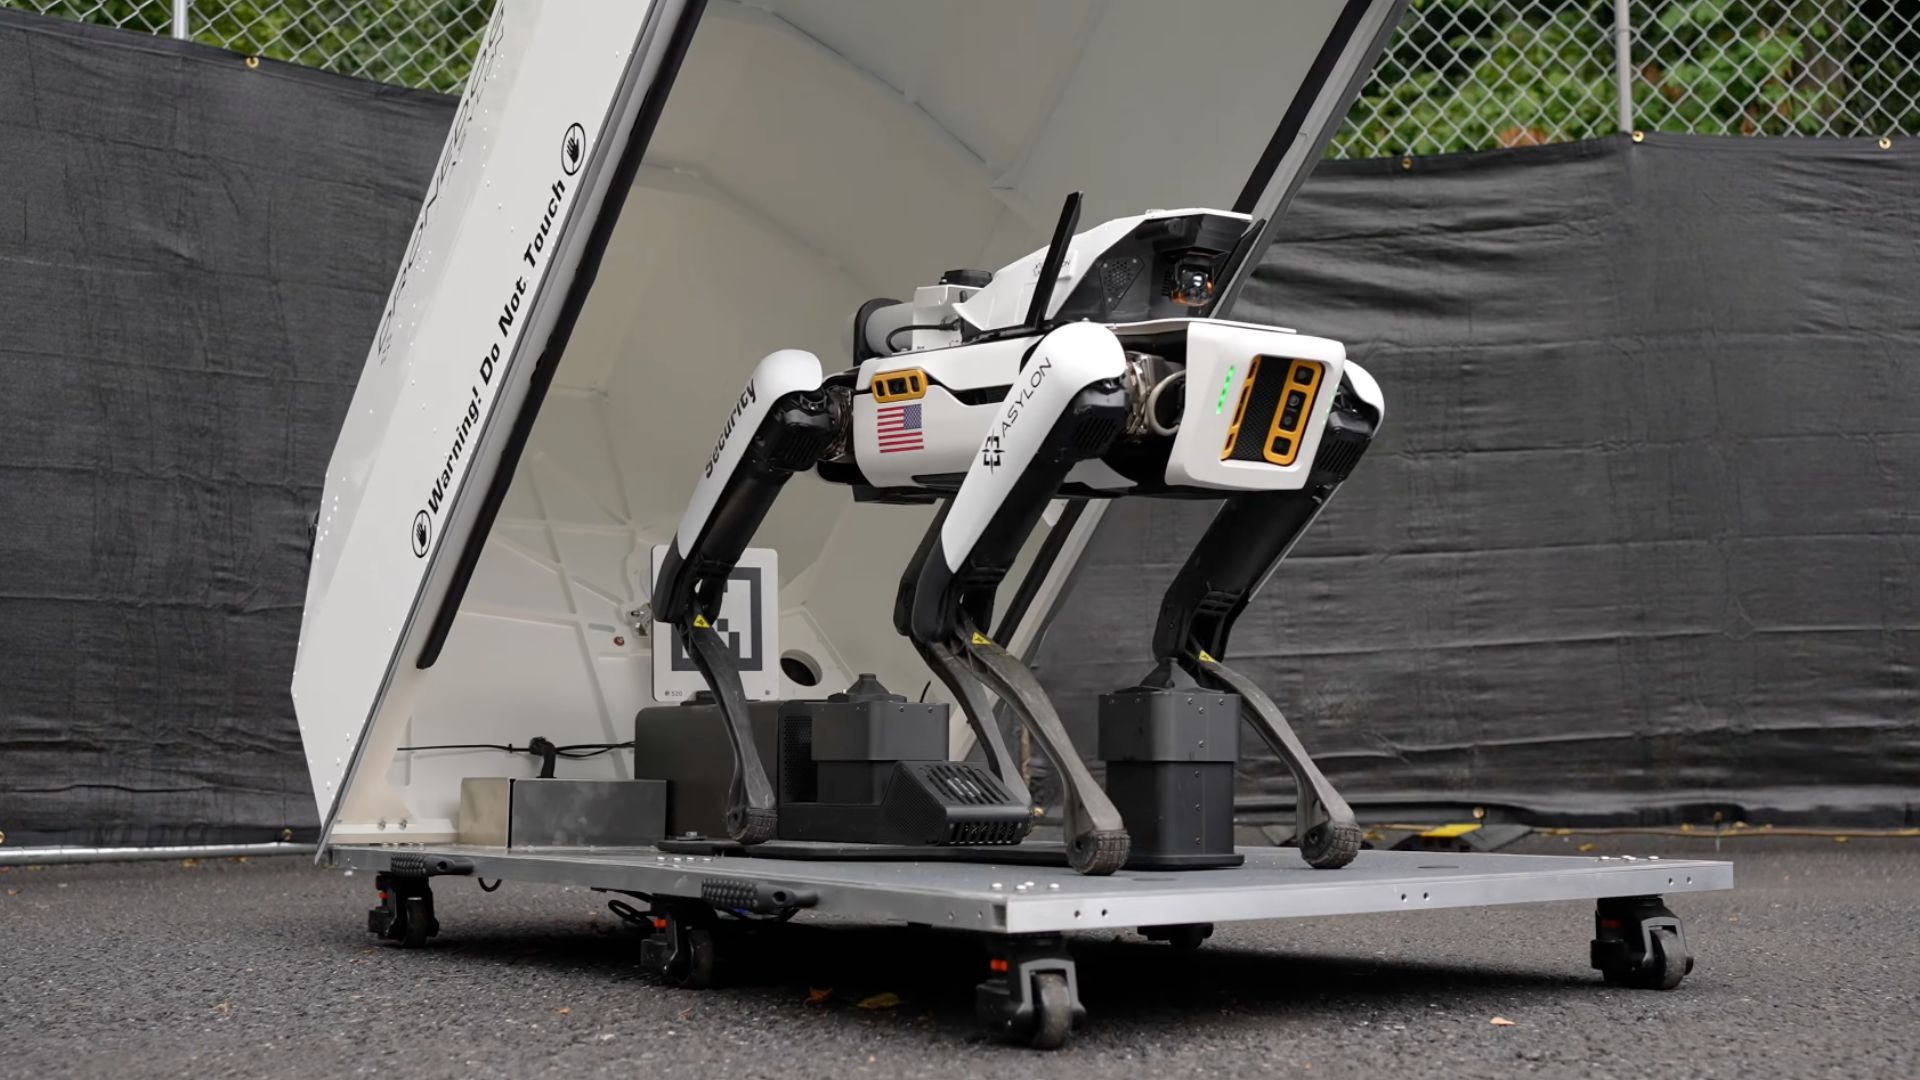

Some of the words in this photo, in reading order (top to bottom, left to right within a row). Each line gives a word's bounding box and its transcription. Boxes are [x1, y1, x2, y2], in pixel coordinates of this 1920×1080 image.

[428, 386, 482, 515] Warning!
[480, 343, 501, 385] Do
[498, 276, 527, 337] Not
[523, 179, 566, 268] Touch
[1002, 357, 1052, 438] ASYLON
